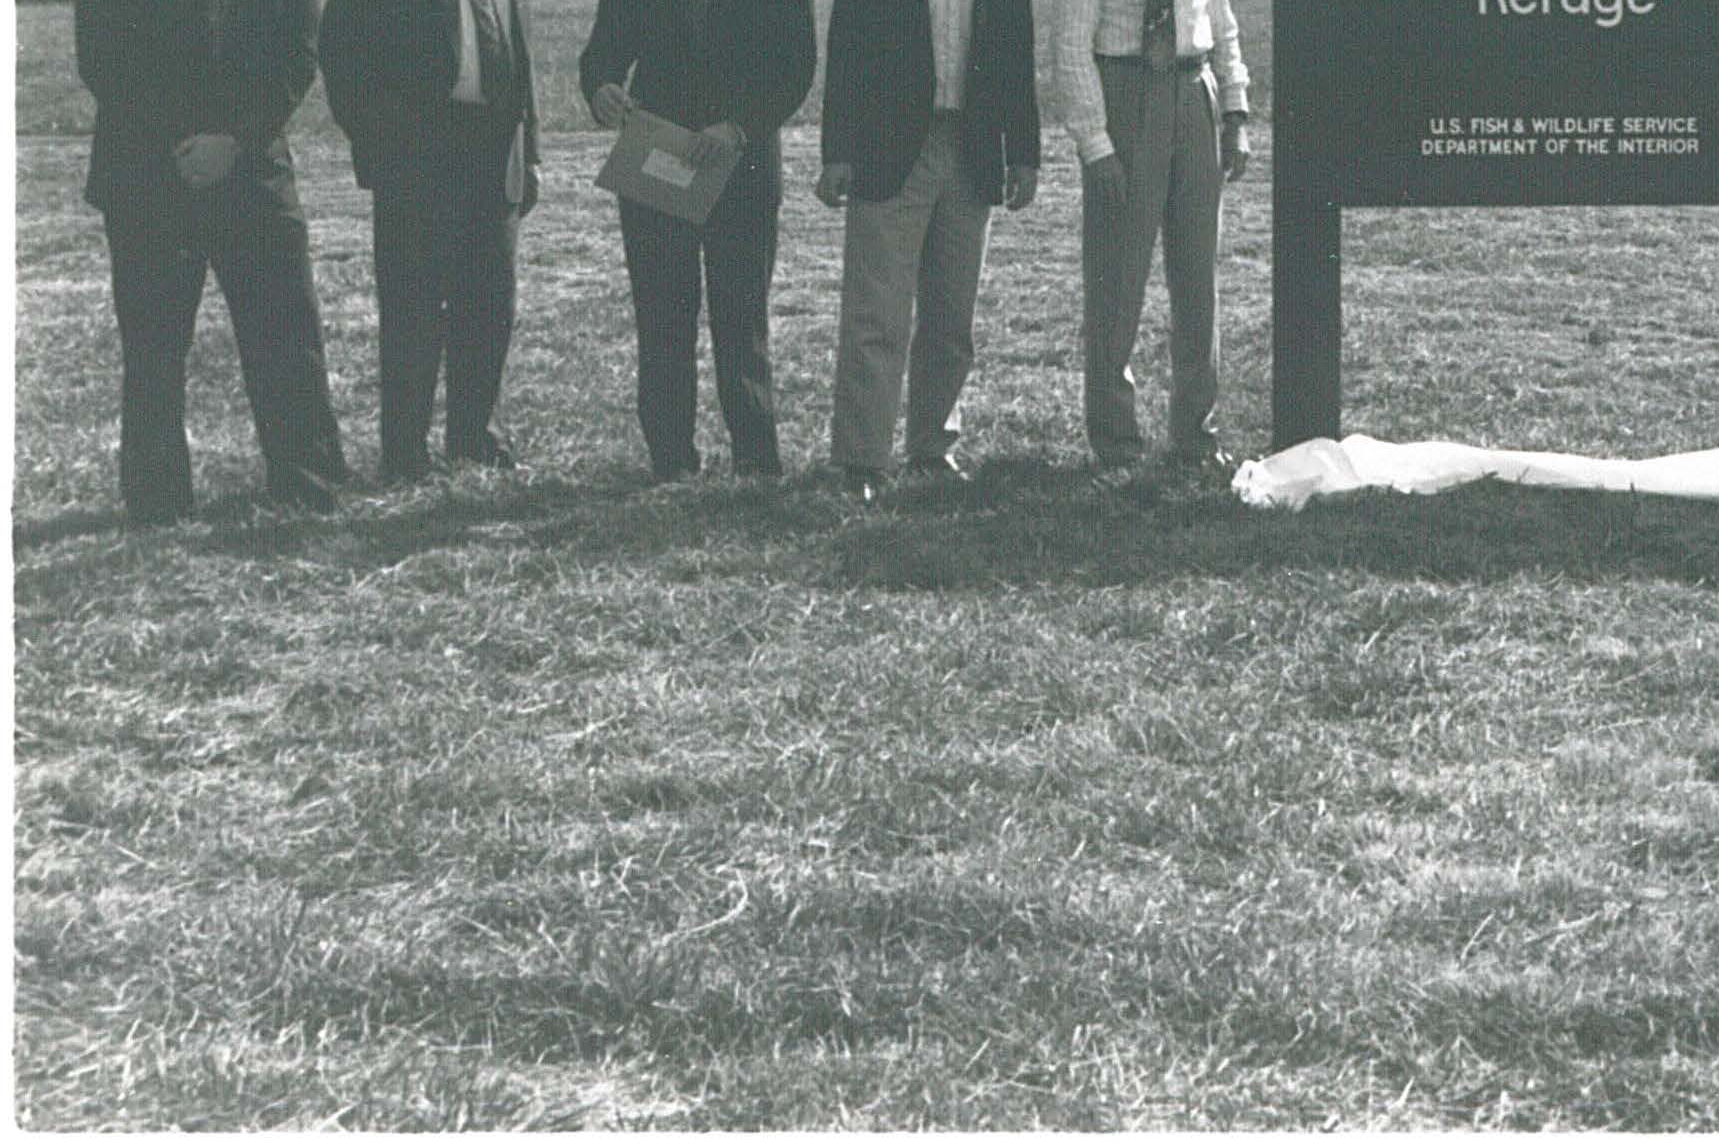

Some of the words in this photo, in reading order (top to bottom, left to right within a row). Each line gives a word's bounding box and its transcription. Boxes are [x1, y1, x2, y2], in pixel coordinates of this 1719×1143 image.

[1430, 117, 1462, 135] U.S.
[1470, 117, 1509, 134] FISH
[1512, 118, 1525, 134] &
[1531, 117, 1615, 134] WILDLIFE
[1622, 117, 1698, 133] SERVICE
[1421, 138, 1538, 156] DEPARTMENT
[1545, 138, 1569, 154] OF
[1574, 138, 1609, 155] THE
[1617, 138, 1699, 154] INTERIOR
